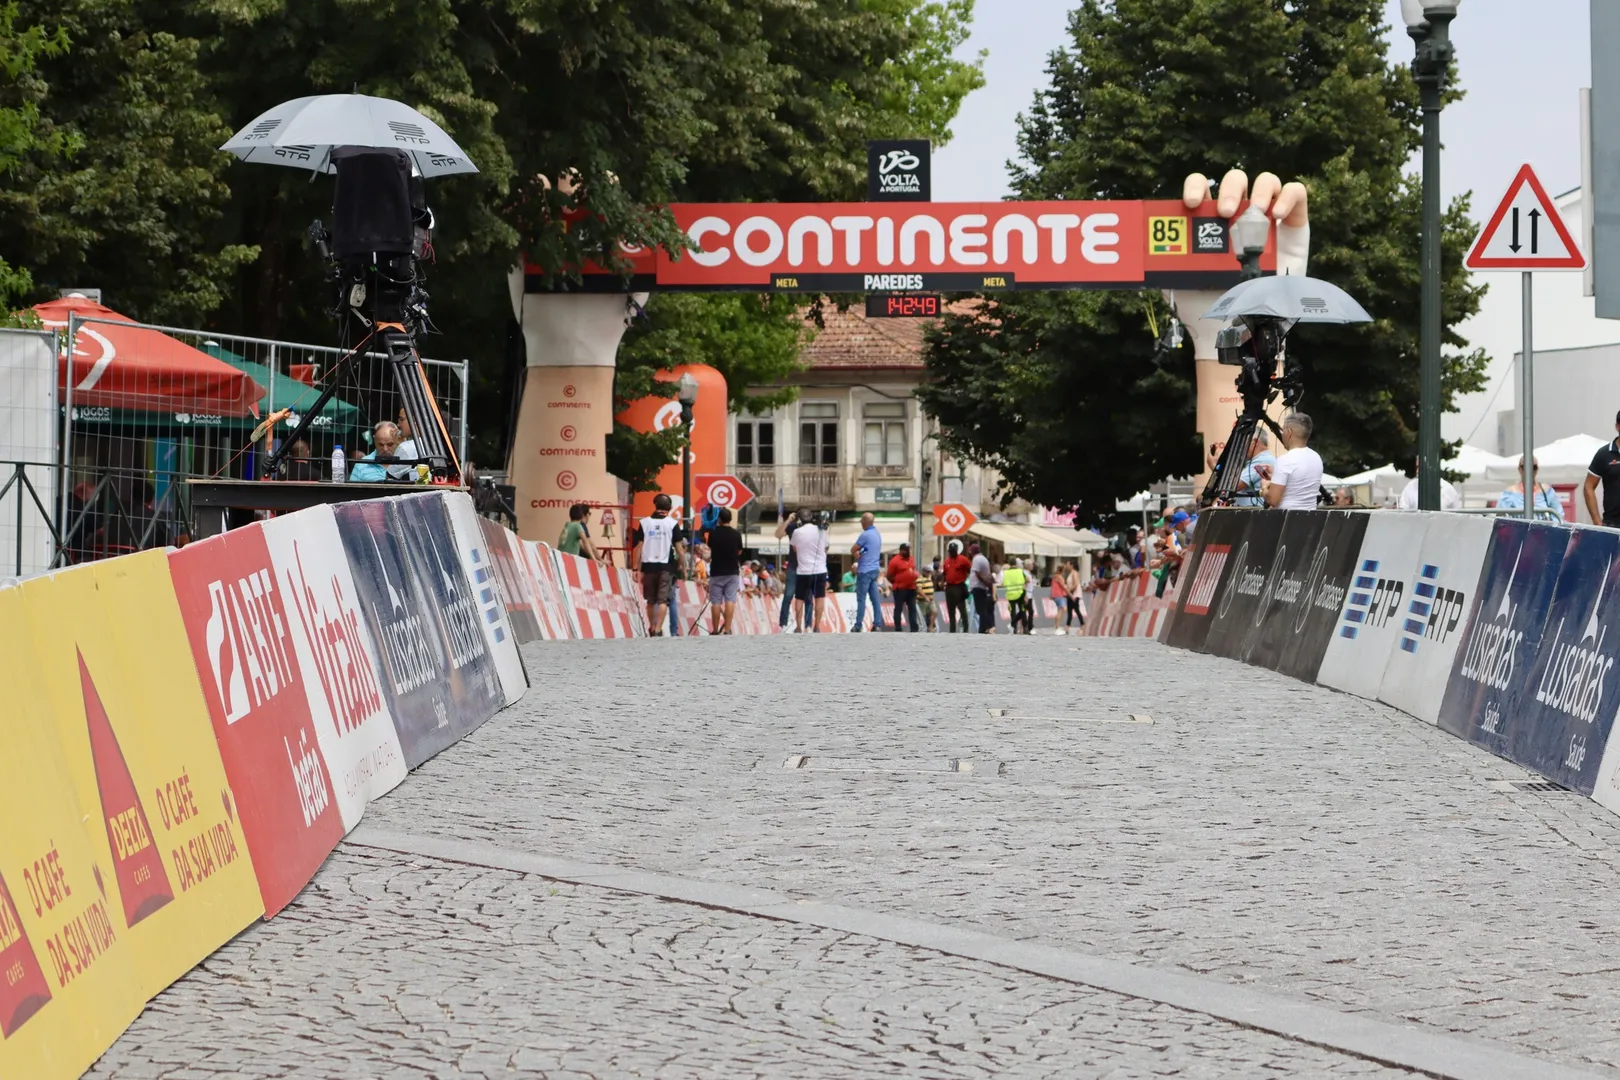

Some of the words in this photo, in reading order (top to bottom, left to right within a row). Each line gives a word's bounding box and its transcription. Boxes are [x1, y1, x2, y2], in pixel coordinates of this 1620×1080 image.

[393, 134, 431, 145] RTP
[879, 174, 920, 186] VOLTA
[687, 213, 1119, 267] CONTINENTE
[776, 278, 798, 288] META
[864, 275, 923, 290] PAREDES
[983, 277, 1005, 287] META
[80, 407, 110, 418] JOGOS
[540, 448, 596, 456] CONTINENTE
[1364, 578, 1404, 628] RTP
[1424, 586, 1464, 644] RTP
[228, 568, 293, 708] ABTF
[287, 539, 381, 739] Vitalis
[156, 787, 171, 831] O
[166, 765, 198, 826] CAFÉ
[109, 805, 151, 861] DELTA
[171, 845, 195, 892] DA
[188, 833, 216, 882] SUA
[208, 820, 239, 868] VIDA
[23, 868, 42, 918] O
[33, 839, 72, 910] CAFÉ
[46, 933, 75, 988] DA
[63, 916, 96, 974] SUA
[83, 899, 117, 956] VIDA
